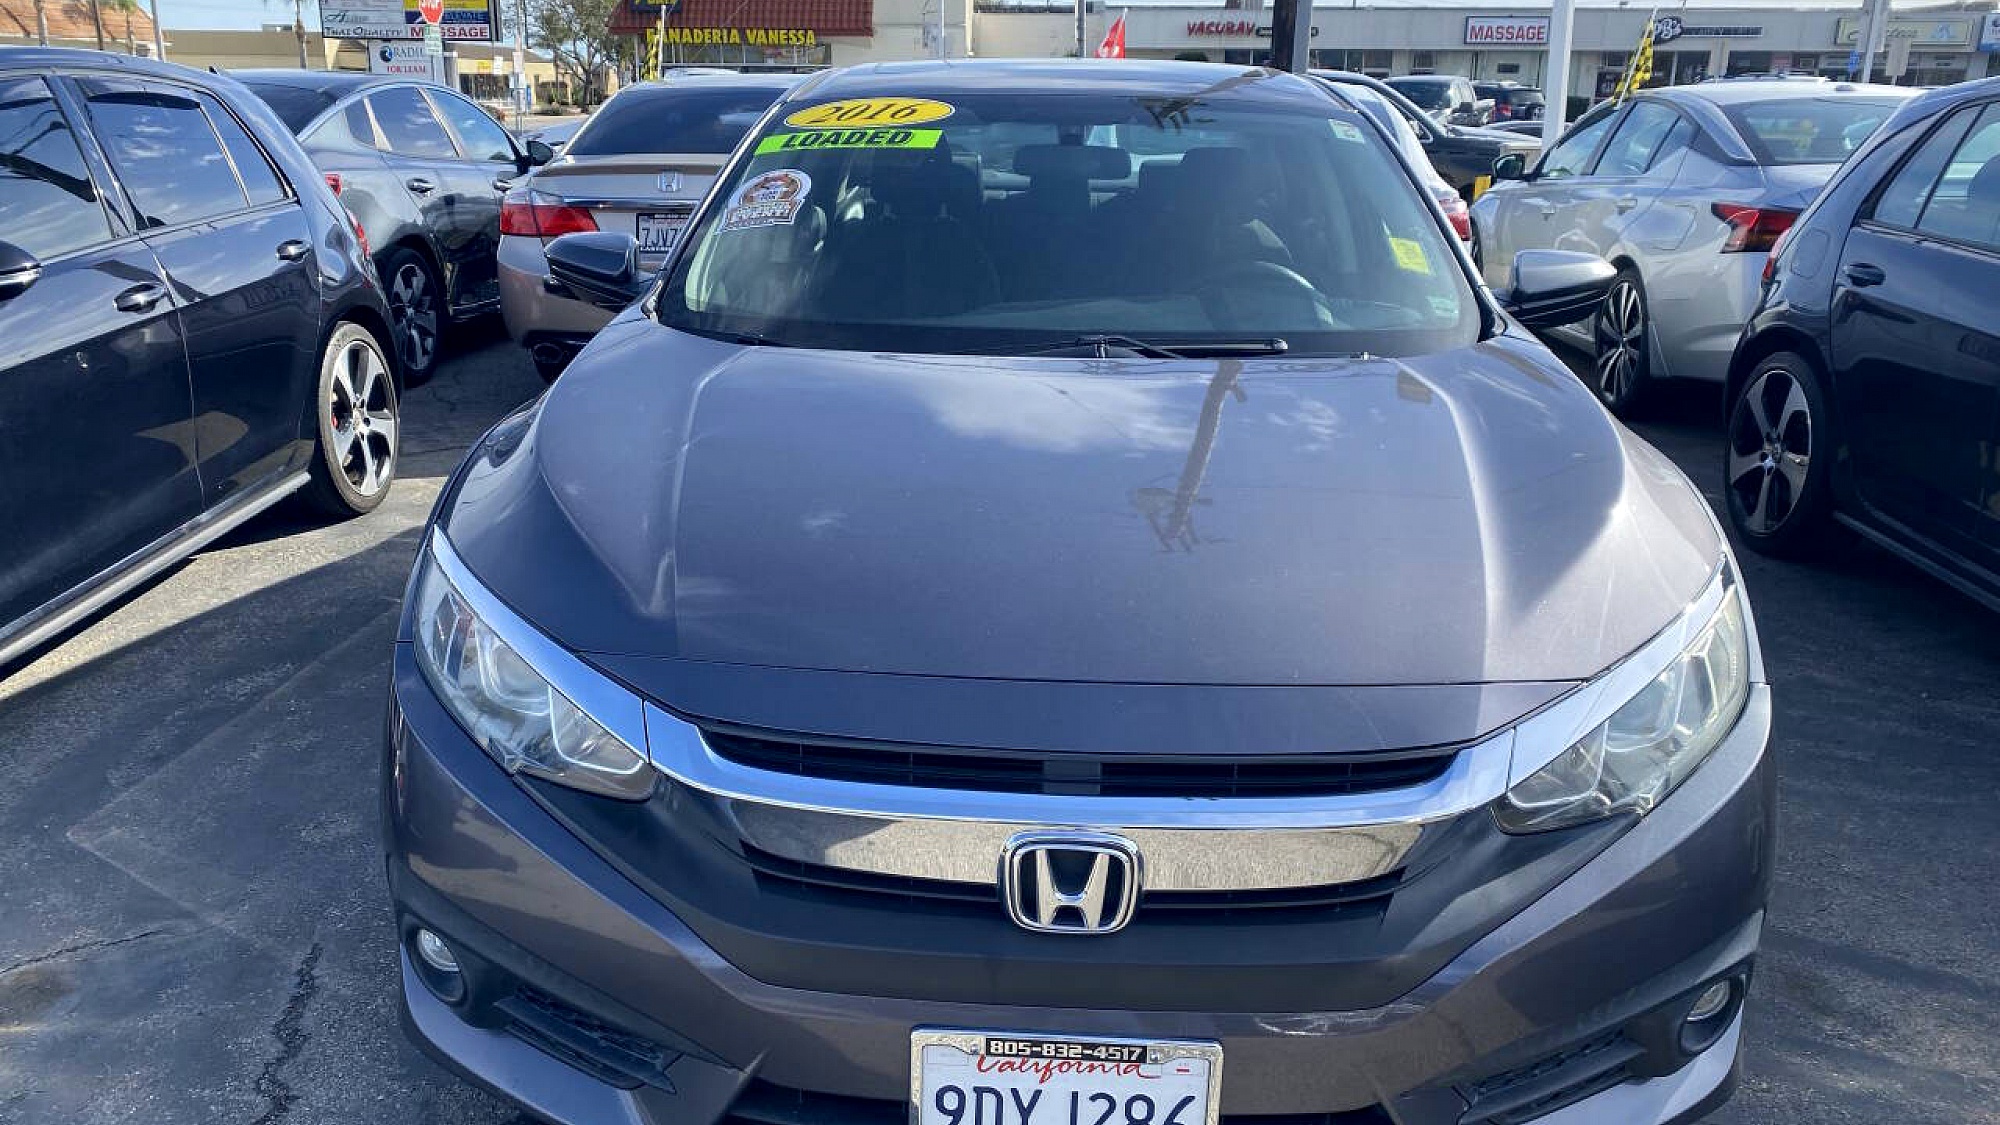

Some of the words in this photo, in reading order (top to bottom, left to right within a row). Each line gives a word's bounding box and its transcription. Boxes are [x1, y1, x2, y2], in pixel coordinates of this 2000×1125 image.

[410, 26, 488, 37] MSSAGE
[746, 28, 816, 45] VANESSA
[1469, 24, 1545, 41] MASSAGE
[810, 102, 918, 124] 2016
[781, 130, 914, 148] LOADED
[641, 228, 683, 250] 7JV7
[989, 1040, 1143, 1061] 805-832-4517
[976, 1053, 1161, 1084] California
